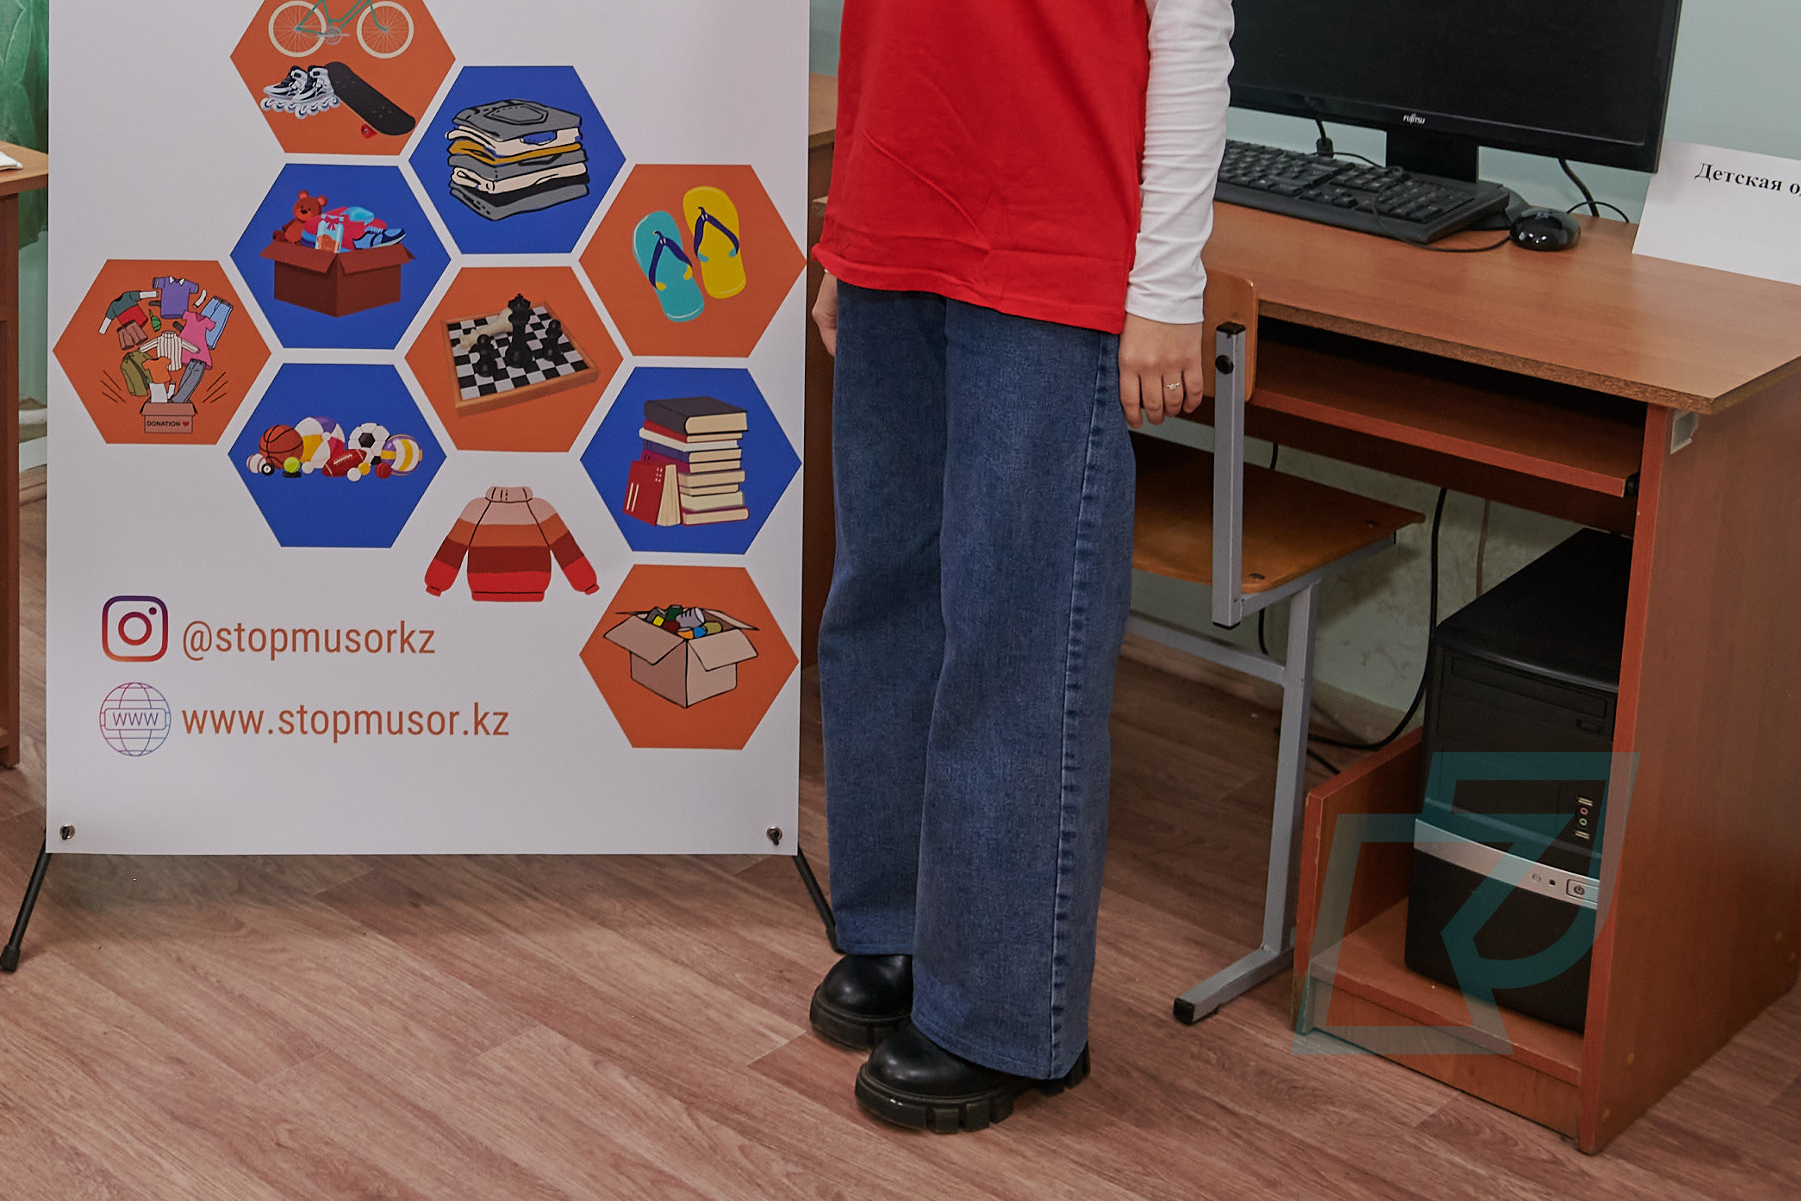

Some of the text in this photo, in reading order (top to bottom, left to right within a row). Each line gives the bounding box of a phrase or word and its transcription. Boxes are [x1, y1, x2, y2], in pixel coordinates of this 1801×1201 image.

[1694, 163, 1801, 197] Детская о
[183, 620, 436, 662] @stopmusorkz
[181, 702, 510, 744] www.stopmusor.kz
